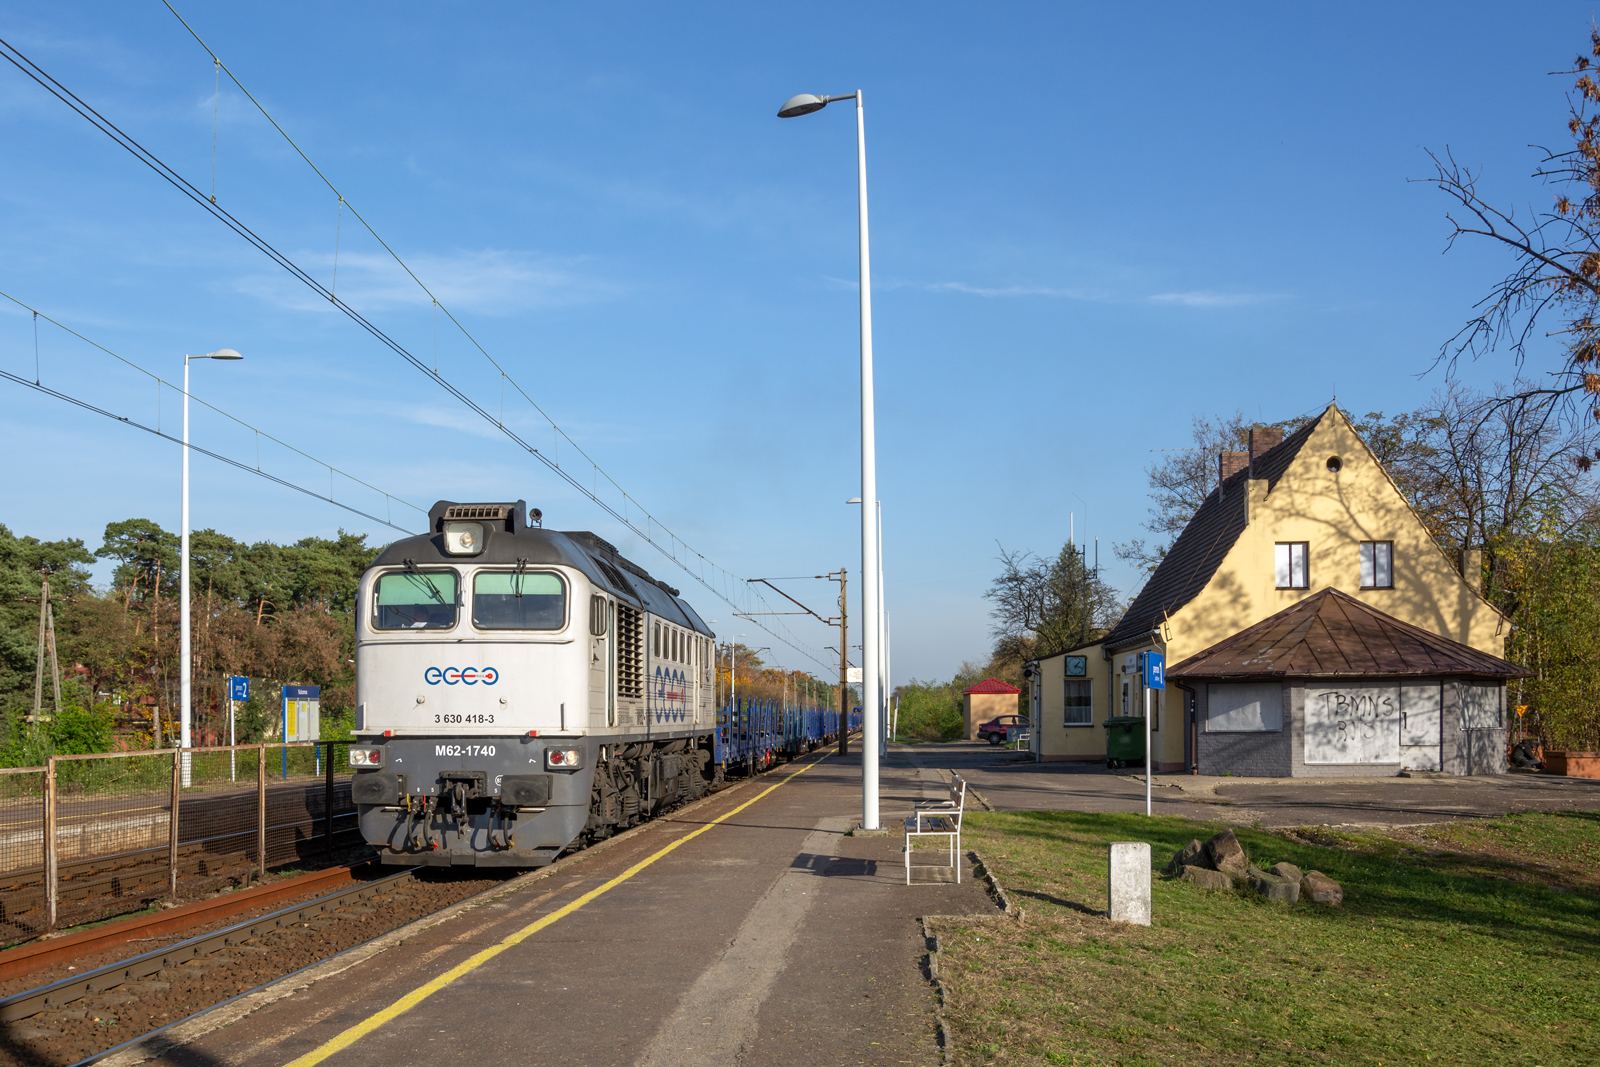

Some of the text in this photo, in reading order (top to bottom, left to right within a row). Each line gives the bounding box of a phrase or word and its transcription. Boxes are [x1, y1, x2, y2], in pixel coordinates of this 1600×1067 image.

[1159, 661, 1163, 684] 1
[242, 682, 247, 698] 2
[434, 714, 495, 724] 3 630 418-3
[435, 745, 496, 757] M62-1740
